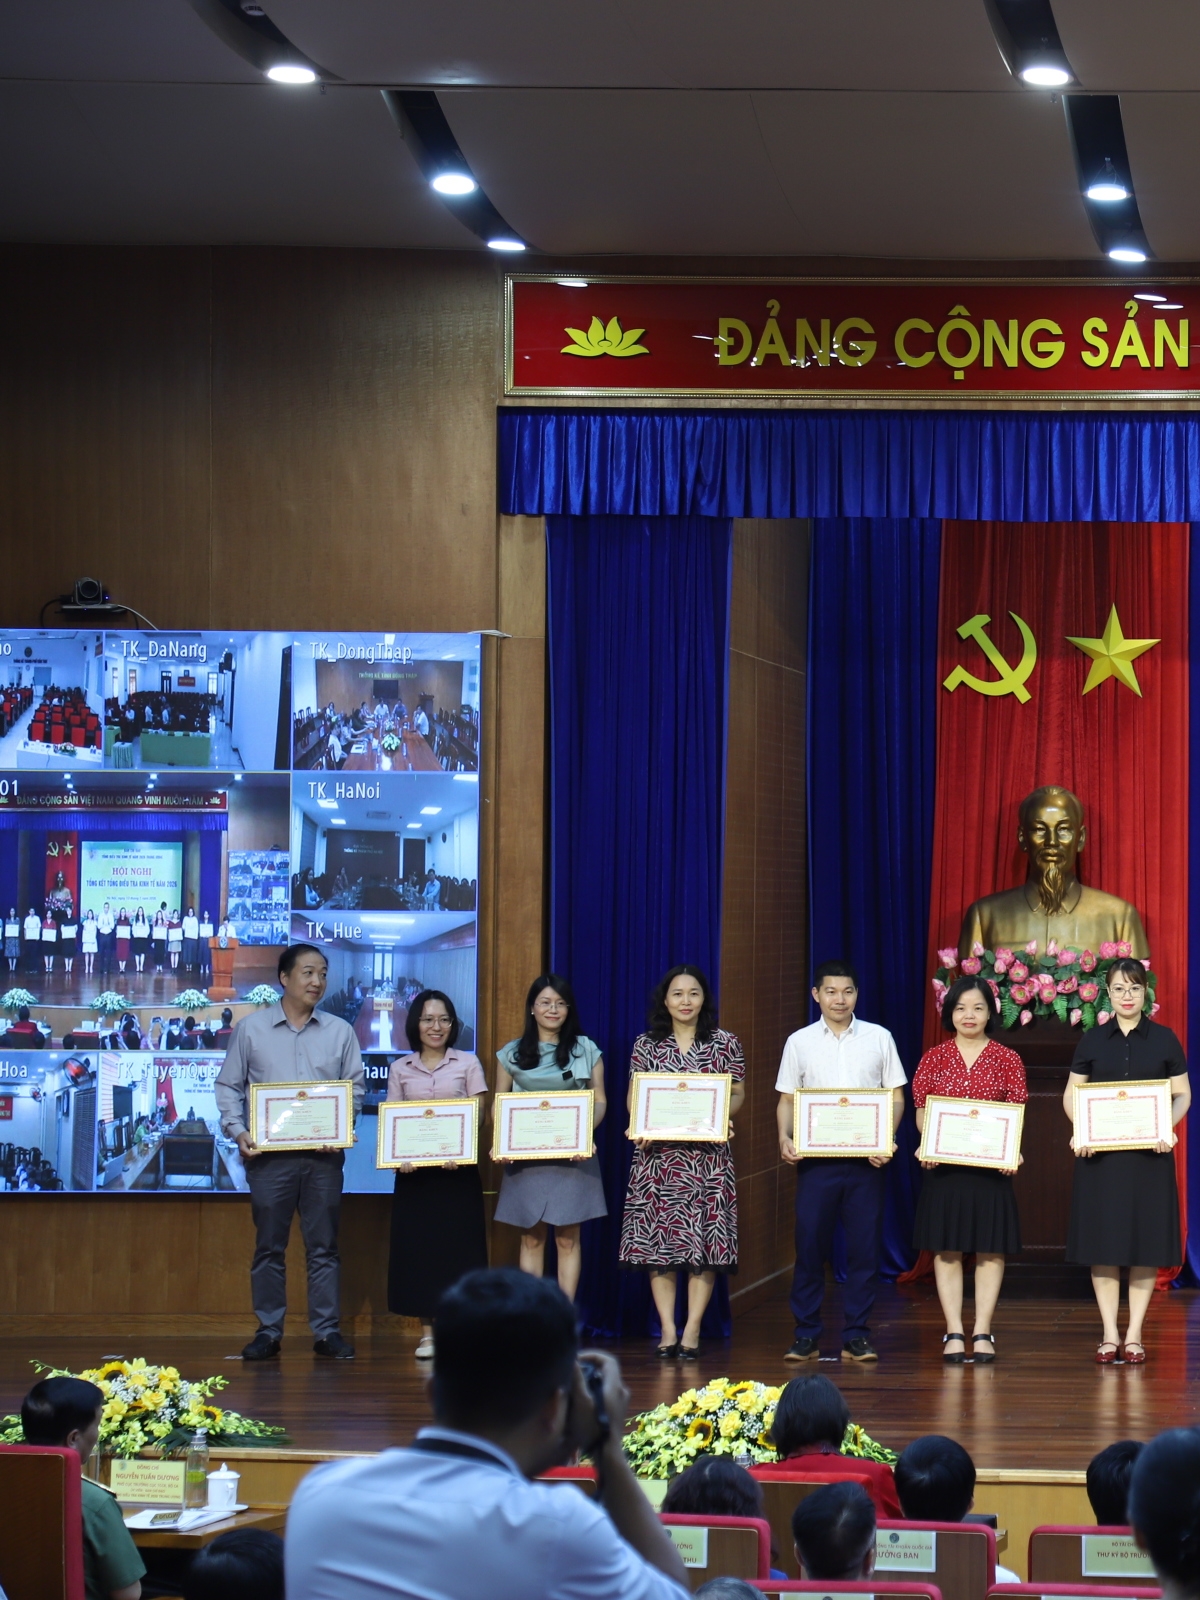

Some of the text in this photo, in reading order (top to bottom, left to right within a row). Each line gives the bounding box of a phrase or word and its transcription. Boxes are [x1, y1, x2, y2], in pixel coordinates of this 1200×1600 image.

[714, 298, 877, 367] ĐẢNG
[894, 306, 1065, 380] CỘNG
[1081, 302, 1190, 368] SẢN
[121, 641, 207, 662] TK_DaNang
[310, 642, 412, 664] TK_DongThap
[63, 792, 78, 804] SẢN
[144, 796, 161, 805] VINH
[308, 782, 380, 802] TK_HaNoi
[306, 922, 362, 942] TK_Hue
[115, 1062, 222, 1083] TK_TuyenQua
[116, 1472, 139, 1480] NGUYỄN
[140, 1473, 156, 1481] TUẤN
